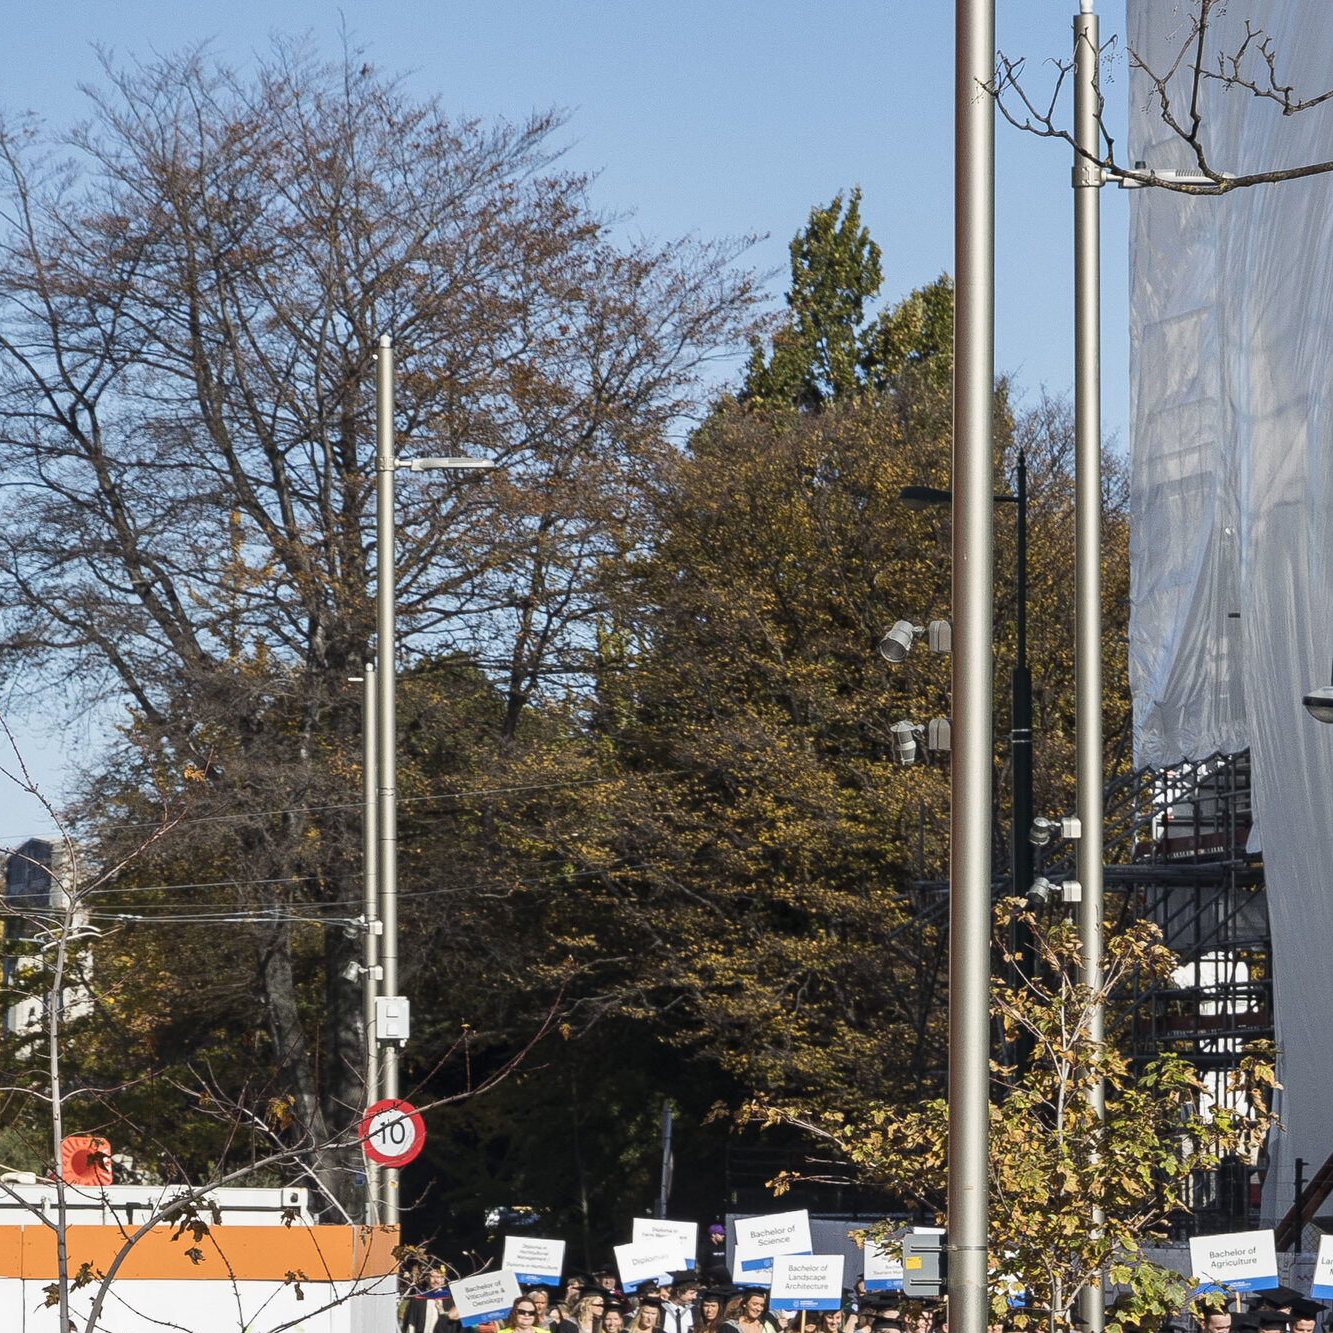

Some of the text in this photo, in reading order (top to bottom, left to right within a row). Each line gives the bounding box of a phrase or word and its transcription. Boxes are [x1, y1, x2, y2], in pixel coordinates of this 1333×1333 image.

[380, 1121, 405, 1144] 10
[750, 1228, 786, 1238] Bachelor
[758, 1236, 790, 1246] Science
[1209, 1248, 1246, 1259] Bachelor
[1210, 1257, 1258, 1269] Agriculture
[788, 1274, 826, 1282] Landscape
[464, 1282, 493, 1293] Bachelor
[466, 1290, 498, 1300] Viticulture
[472, 1296, 504, 1308] Oenology
